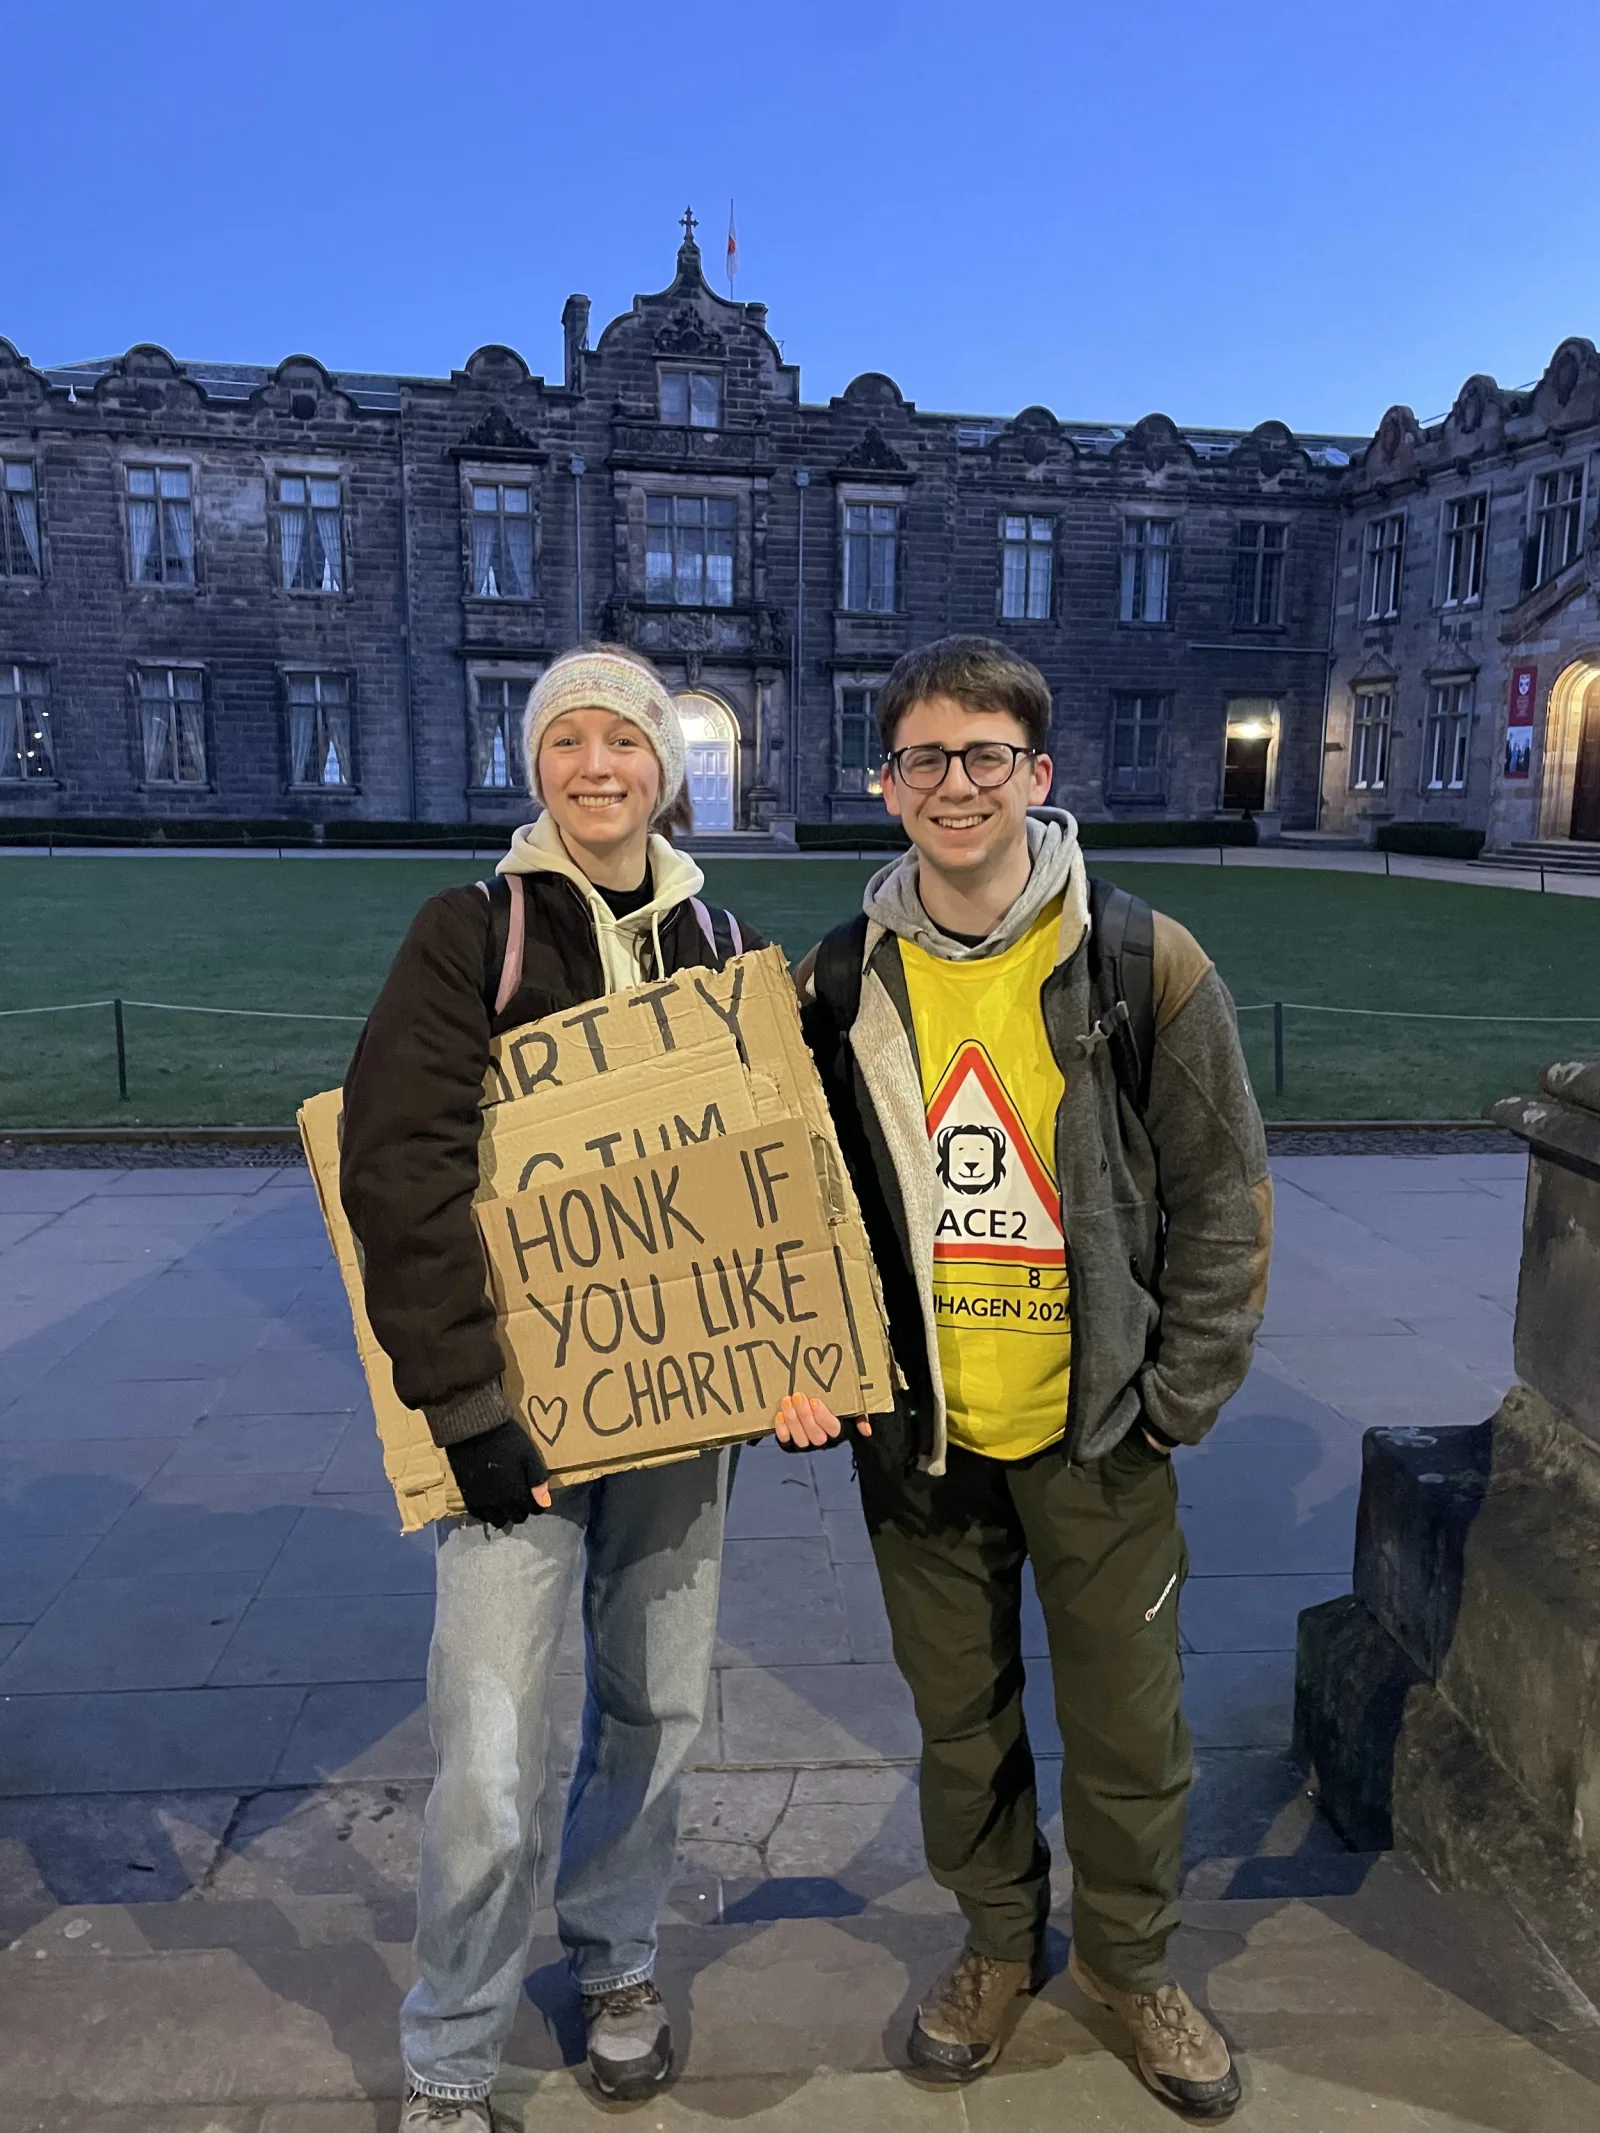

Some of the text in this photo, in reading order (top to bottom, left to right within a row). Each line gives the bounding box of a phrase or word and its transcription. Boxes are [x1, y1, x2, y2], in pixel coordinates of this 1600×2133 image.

[505, 1165, 705, 1283] HONK
[740, 1141, 789, 1229] IF
[935, 1208, 1027, 1240] ACE2
[525, 1239, 818, 1368] YOU LIKE
[1027, 1301, 1070, 1321] 202
[1028, 1267, 1041, 1288] 8
[582, 1335, 801, 1437] CHARITY
